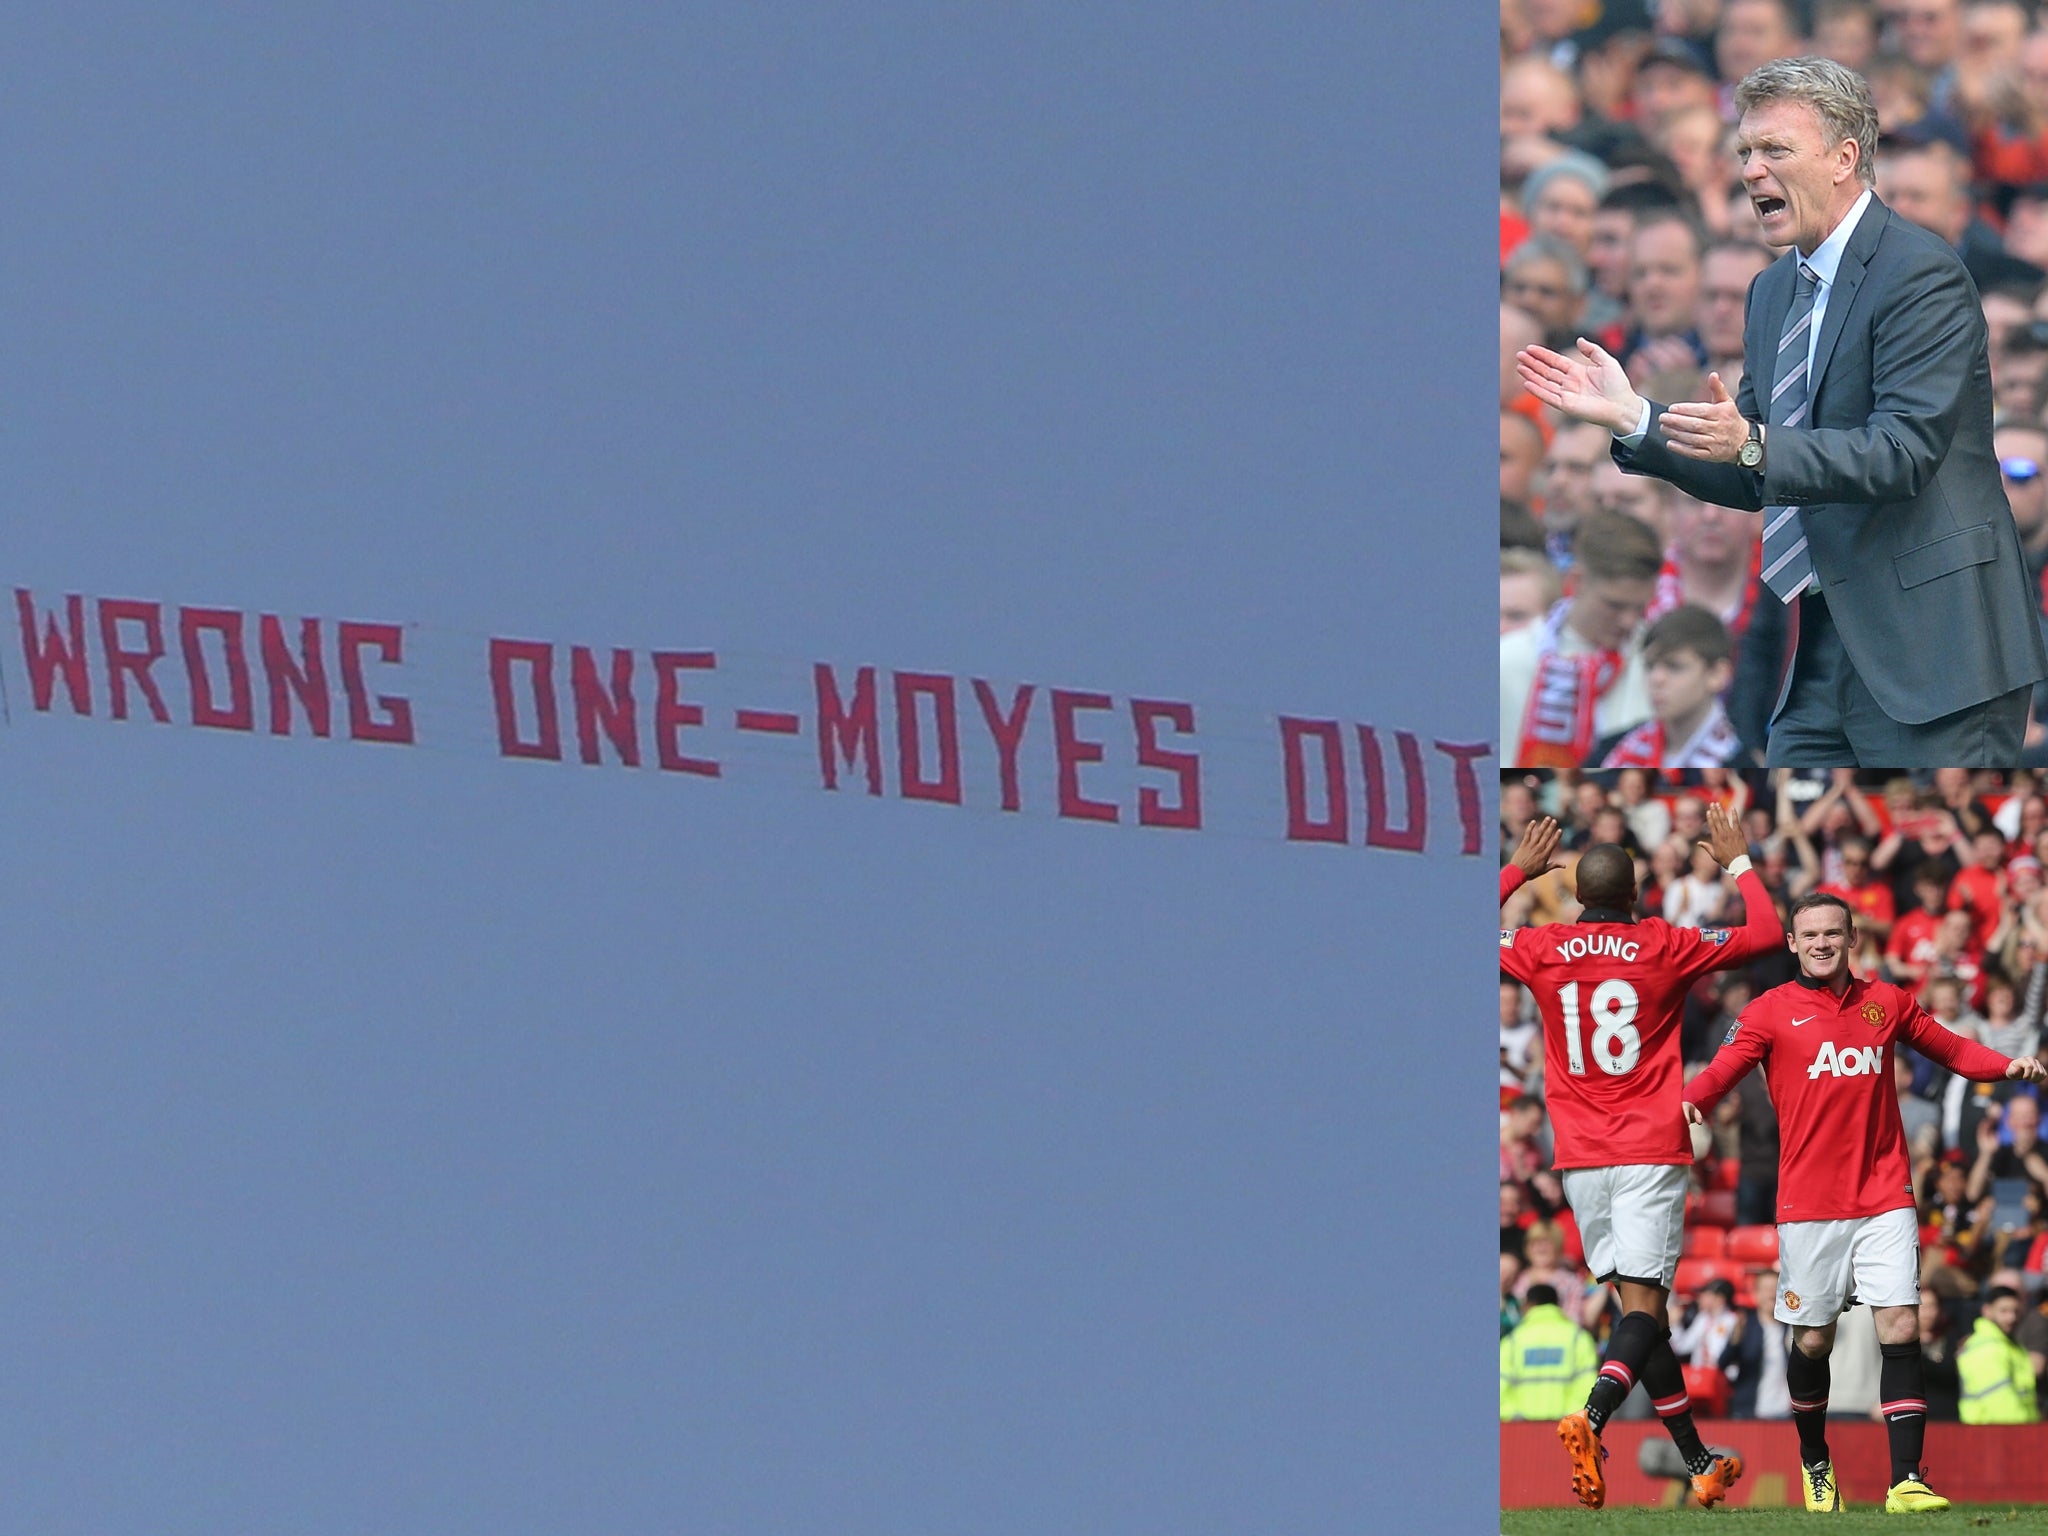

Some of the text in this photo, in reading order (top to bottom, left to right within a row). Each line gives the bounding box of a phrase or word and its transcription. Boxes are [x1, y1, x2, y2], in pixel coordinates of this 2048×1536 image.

[14, 587, 416, 745] WRONG
[1278, 714, 1493, 858] OUT
[1556, 934, 1640, 963] YOUNG
[1557, 978, 1641, 1076] 18
[1806, 1041, 1884, 1080] AON
